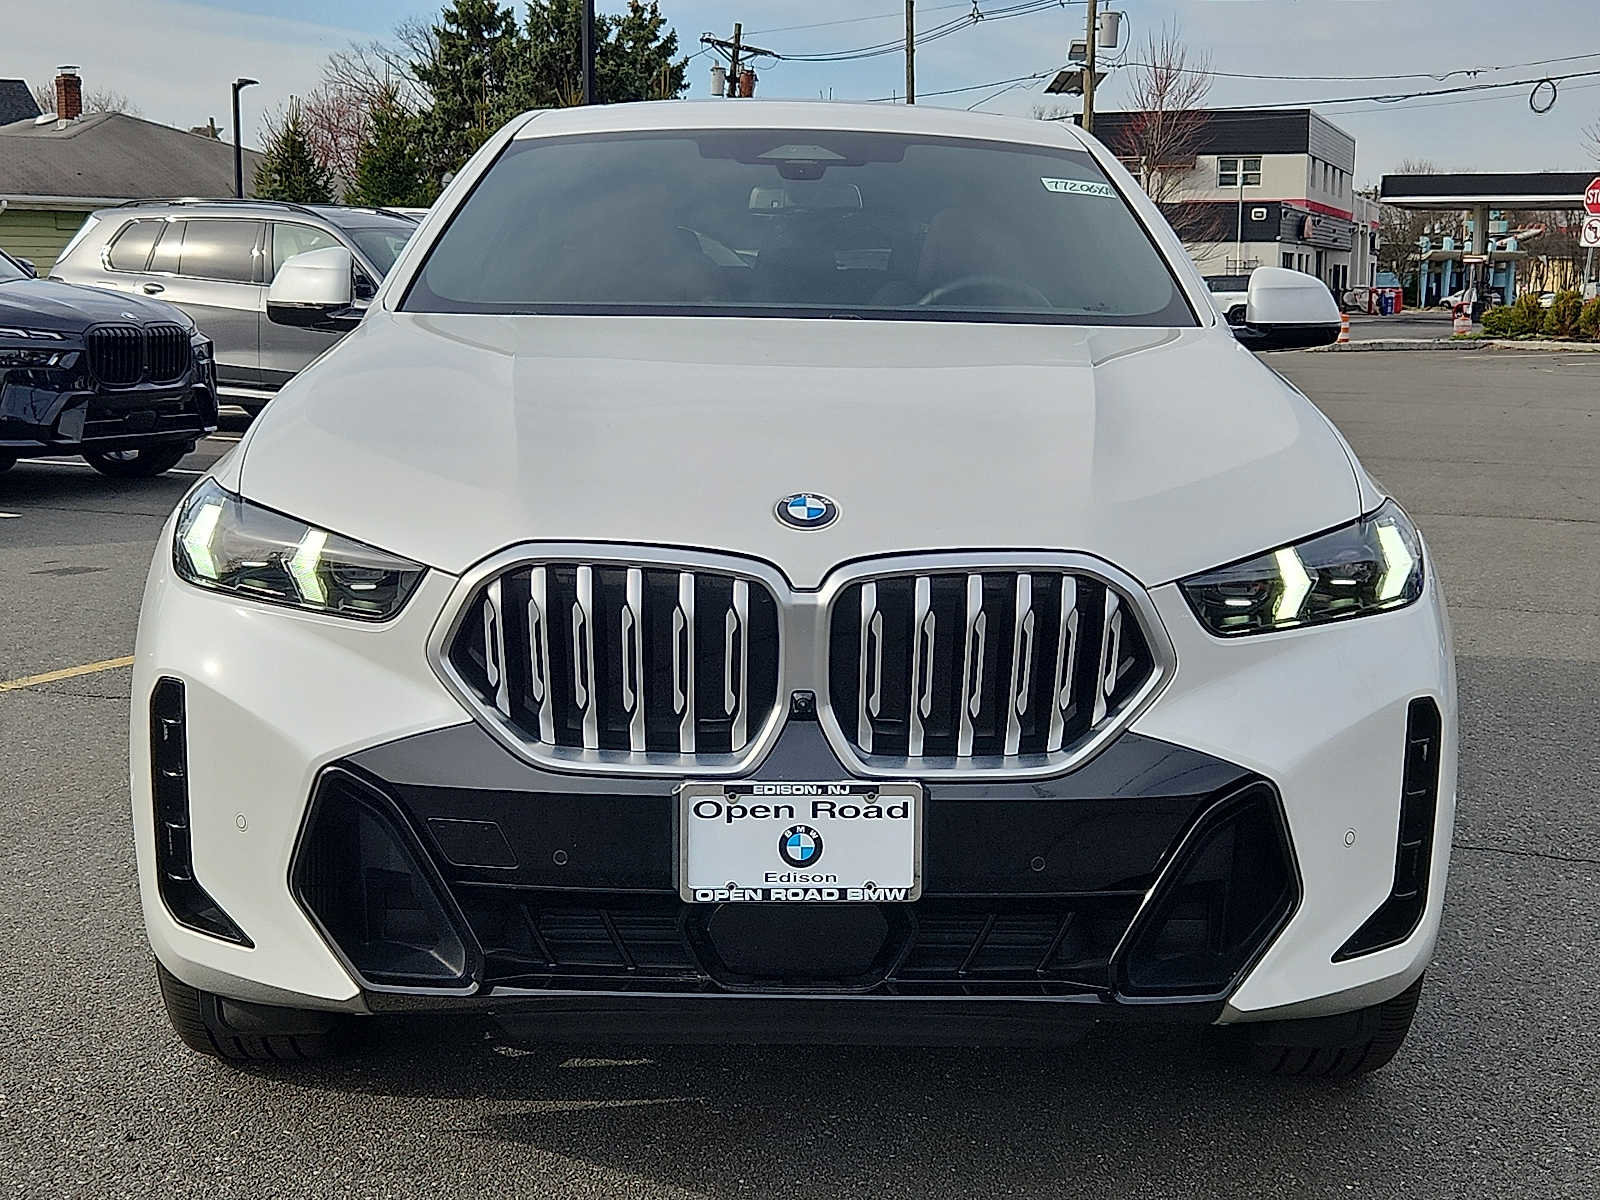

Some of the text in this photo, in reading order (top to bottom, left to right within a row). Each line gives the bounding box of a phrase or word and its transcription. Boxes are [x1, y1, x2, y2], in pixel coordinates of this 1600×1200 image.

[752, 785, 850, 795] EDISON, NJ
[693, 801, 909, 823] Open Road
[783, 826, 818, 839] BMW
[764, 872, 837, 883] Edison
[695, 889, 907, 901] OPEN ROAD BMW
